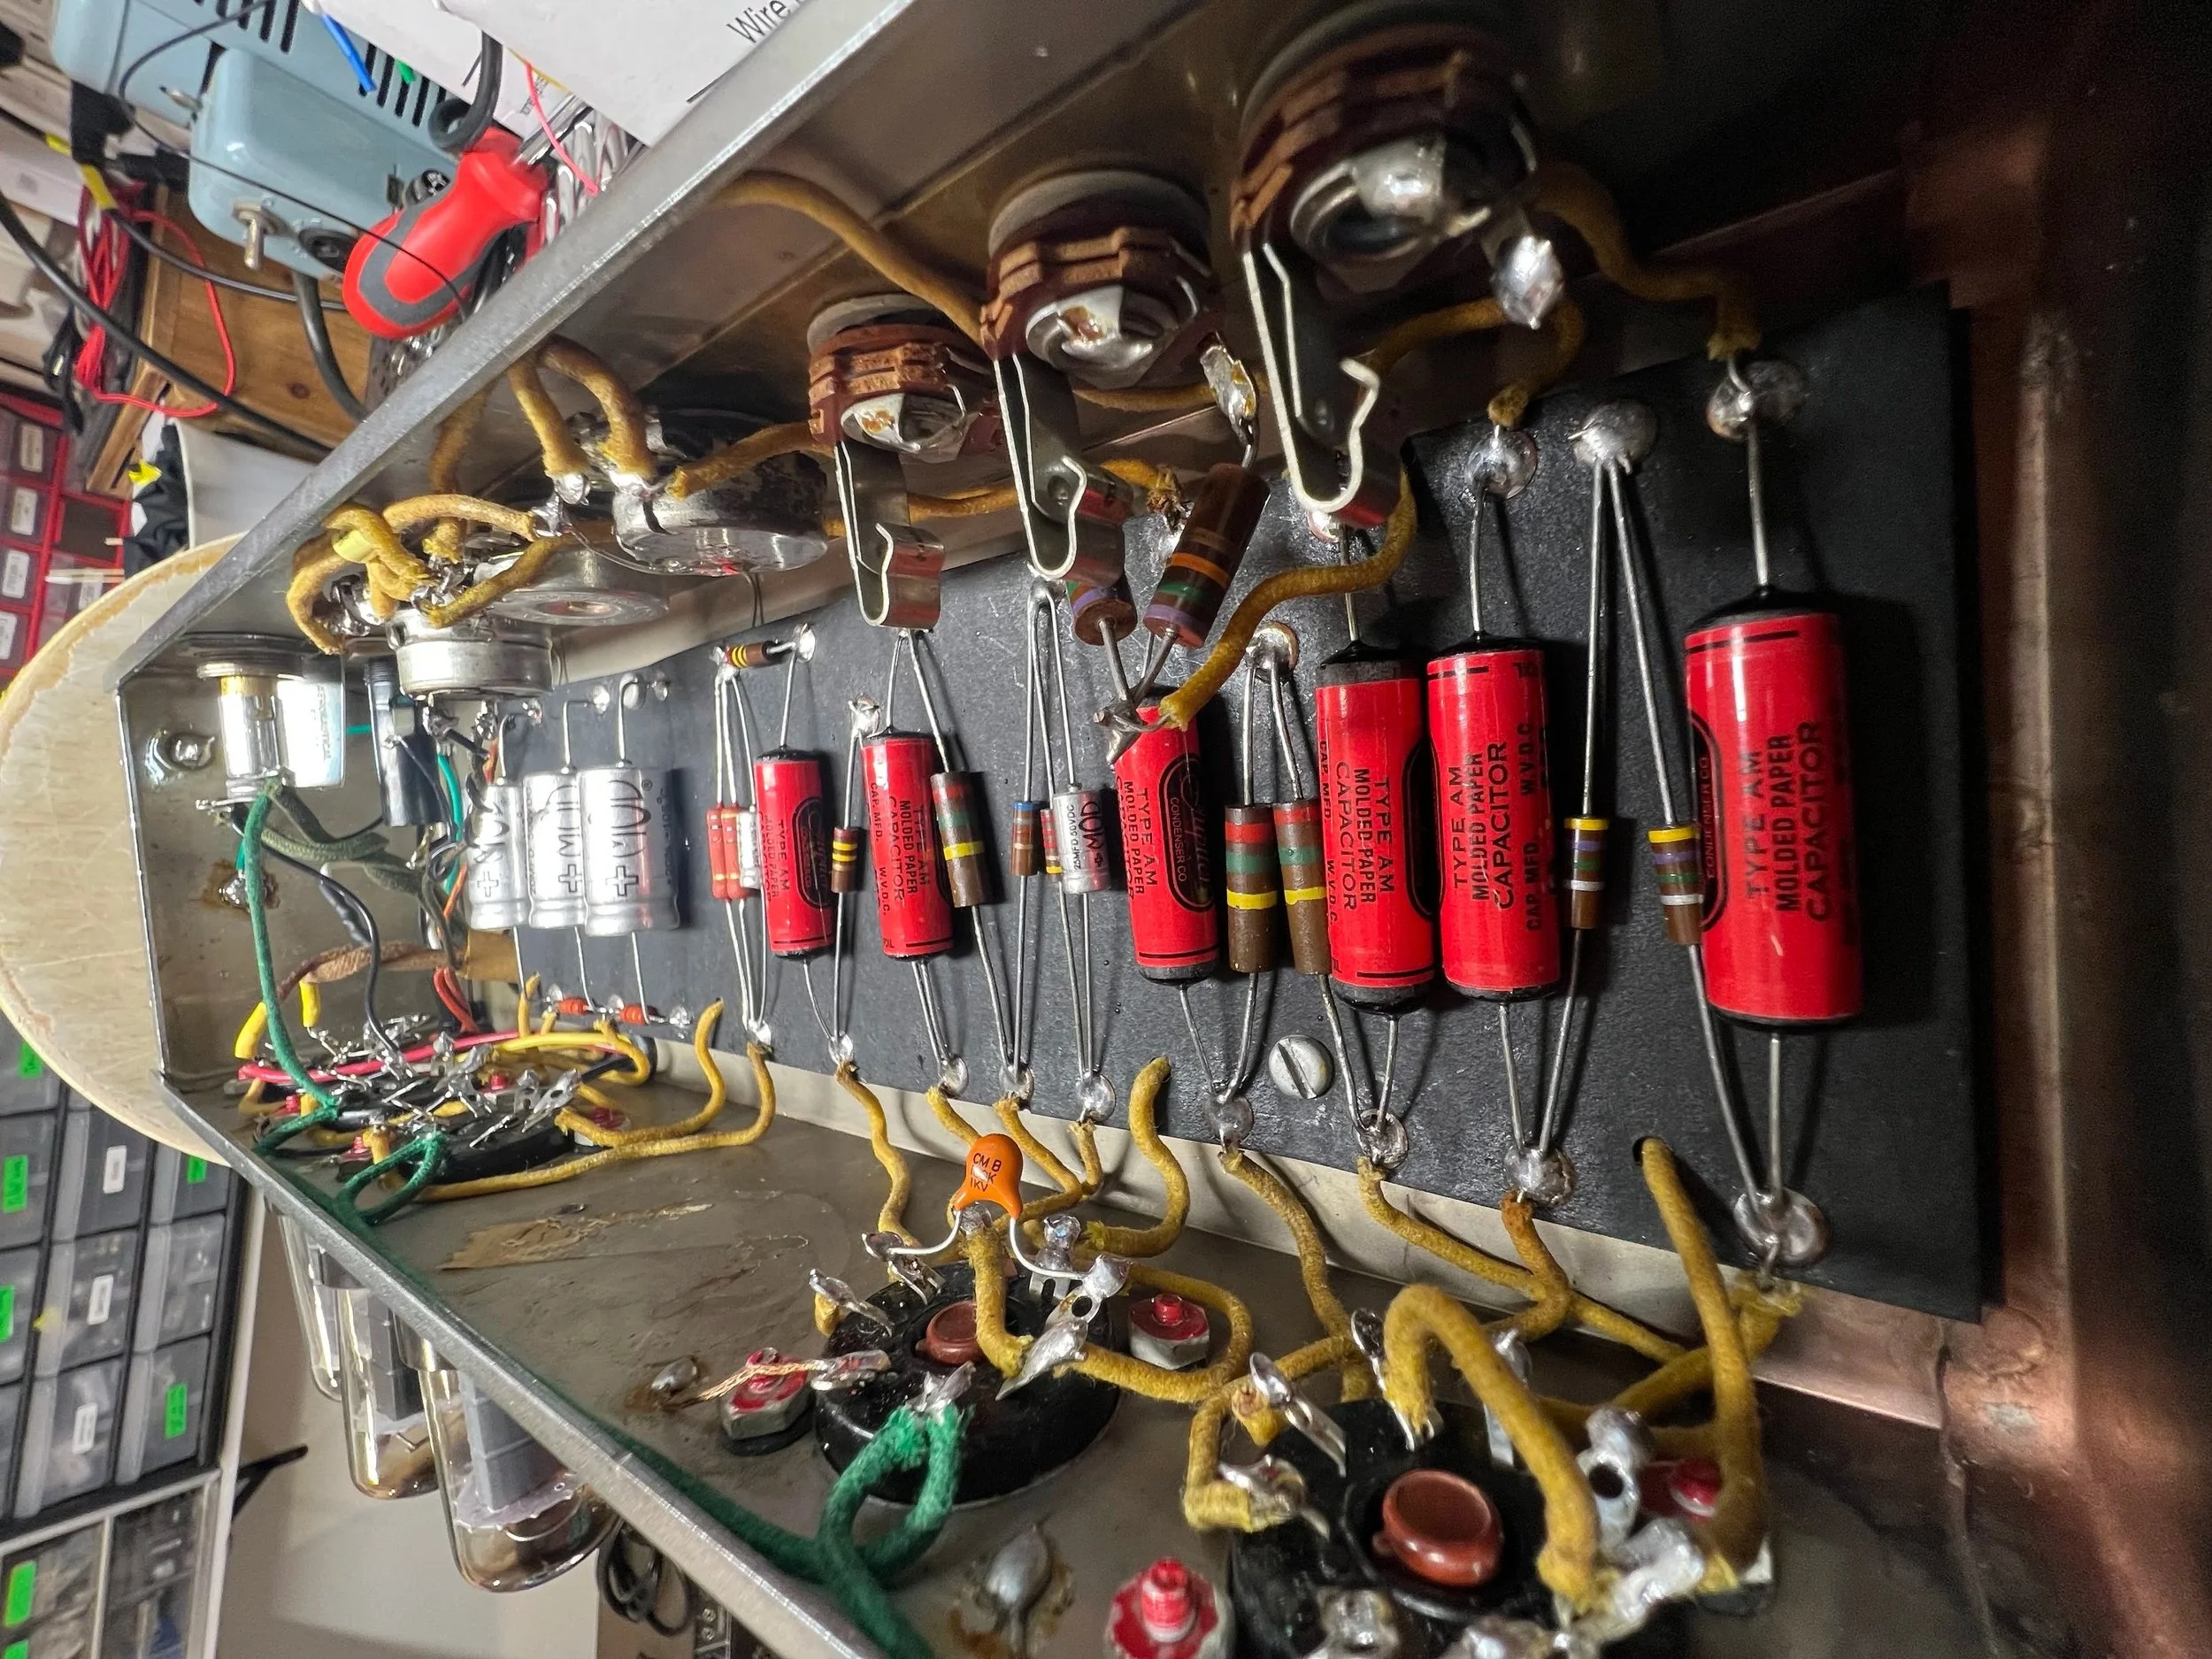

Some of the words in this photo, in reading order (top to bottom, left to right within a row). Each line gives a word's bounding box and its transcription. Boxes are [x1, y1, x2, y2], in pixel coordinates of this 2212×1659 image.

[726, 0, 791, 43] Wire
[870, 782, 879, 809] CAP.
[1448, 765, 1463, 806] AM
[1465, 752, 1486, 814] PAPER
[1739, 751, 1763, 799] AM
[1767, 734, 1794, 808] PAPER
[873, 812, 883, 841] MFD.
[900, 800, 913, 851] MOLDED
[913, 805, 927, 851] TYPE
[1079, 801, 1104, 849] MOD
[1137, 787, 1152, 846] TYPE
[1170, 796, 1186, 864] CONDENSER
[1354, 768, 1373, 841] MOLDED
[1374, 777, 1393, 846] TYPE
[1487, 741, 1514, 910] CAPACITOR
[1796, 720, 1832, 921] CAPACITOR
[765, 815, 775, 863] MOLDED
[770, 862, 780, 898] PAPER
[778, 821, 787, 861] TYPE
[888, 795, 905, 902] CAPACITOR
[1124, 781, 1139, 842] MOLDED
[1132, 848, 1144, 895] PAPER
[1335, 761, 1356, 910] CAPACITOR
[1451, 817, 1467, 889] TYPE
[1468, 822, 1489, 901] MOLDED
[1744, 813, 1770, 900] TYPE
[780, 869, 790, 891] AM
[905, 854, 918, 895] PAPER
[918, 856, 930, 886] AM
[1143, 854, 1157, 886] AM
[1357, 848, 1376, 903] PAPER
[1378, 855, 1394, 893] AM
[1772, 817, 1801, 911] MOLDED
[879, 867, 890, 916] W.V.D.C.
[971, 1177, 988, 1192] 1KV
[973, 1152, 990, 1168] CM
[991, 1159, 1002, 1172] B
